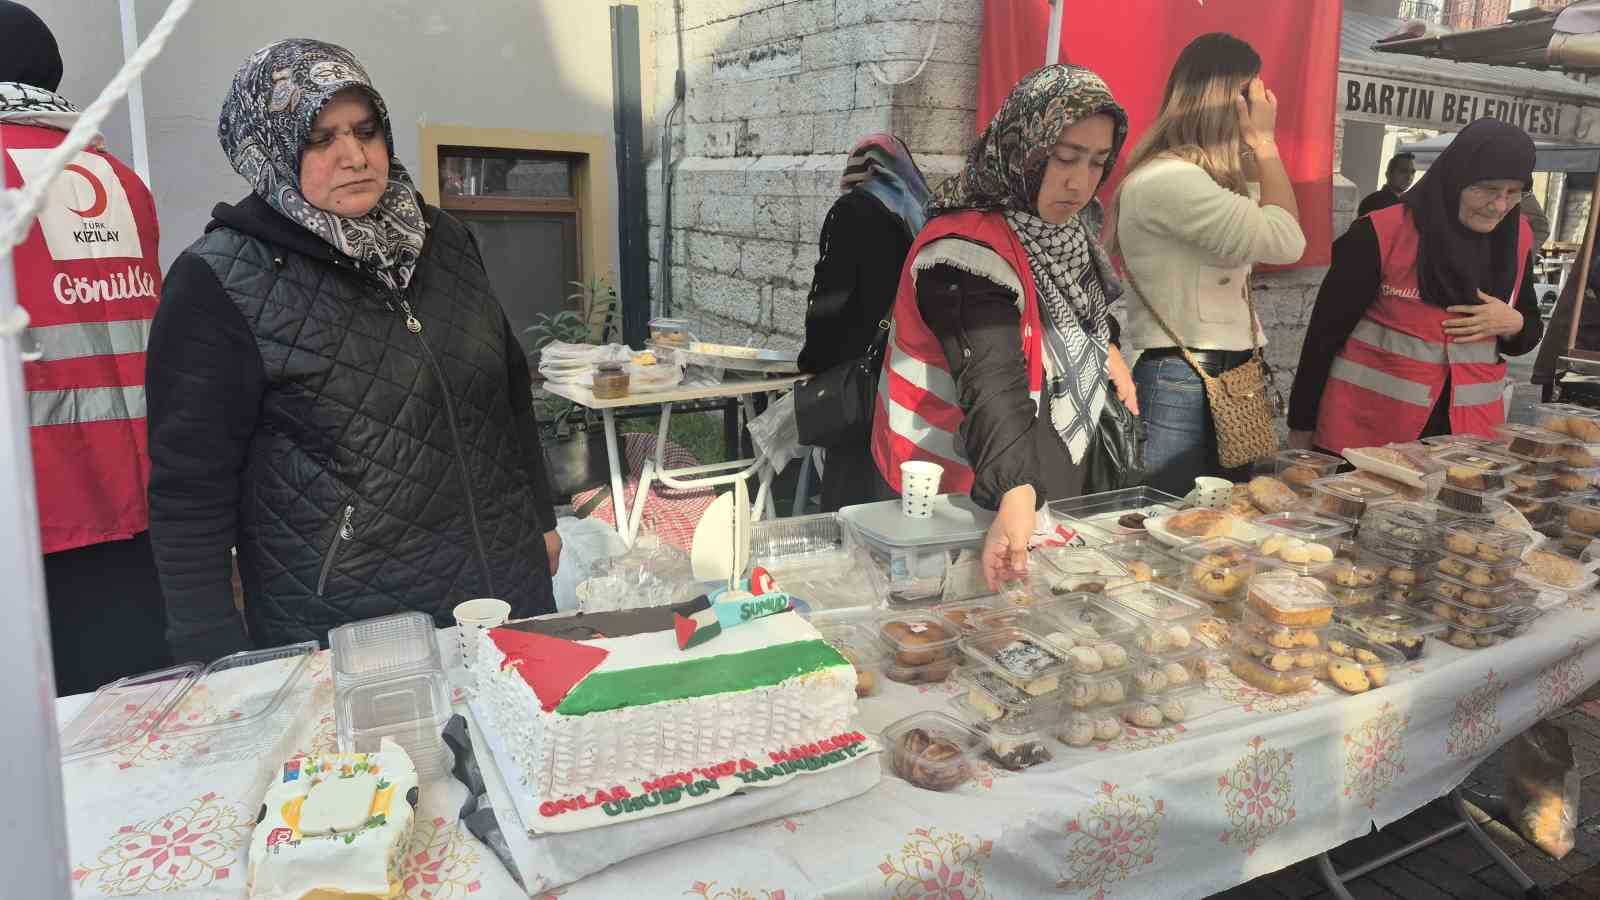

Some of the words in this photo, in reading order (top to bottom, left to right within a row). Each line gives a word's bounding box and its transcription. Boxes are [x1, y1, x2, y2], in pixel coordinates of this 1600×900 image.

[1346, 80, 1434, 121] BARTIN
[73, 231, 120, 243] KIZILAY
[740, 594, 787, 620] SUMUD
[538, 786, 631, 817] ONLAR
